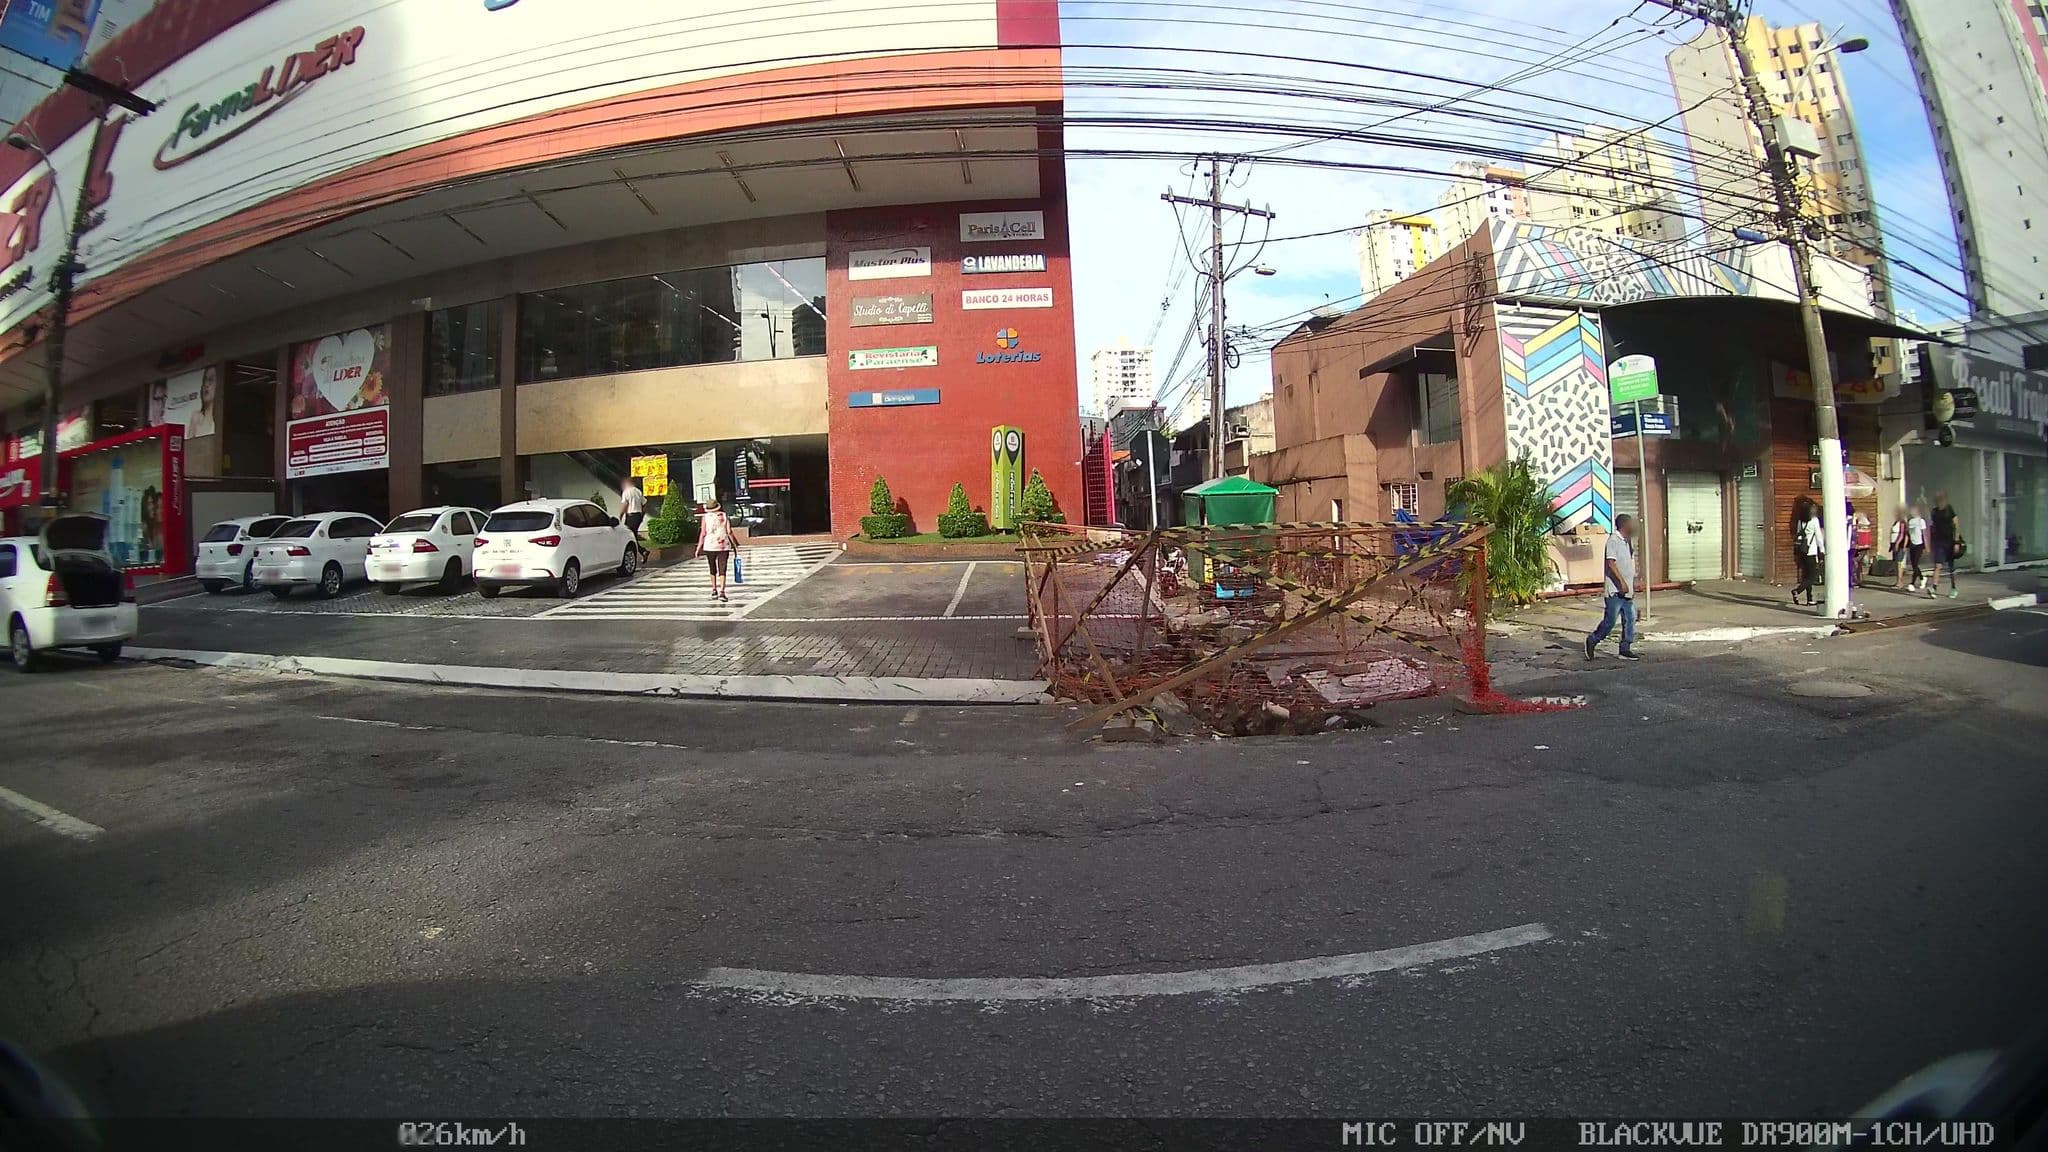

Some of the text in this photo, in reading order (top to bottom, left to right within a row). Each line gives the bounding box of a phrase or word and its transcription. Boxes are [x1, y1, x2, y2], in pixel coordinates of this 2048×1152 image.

[28, 0, 50, 22] TIM
[968, 224, 1000, 235] Paris
[1010, 221, 1036, 233] Cell
[853, 256, 926, 268] Master Plus
[978, 254, 1046, 273] LAVANDERIA
[966, 293, 1049, 304] BANCO 24 HORAS
[854, 302, 929, 317] Studio di Capelli
[865, 358, 923, 367] Paraense
